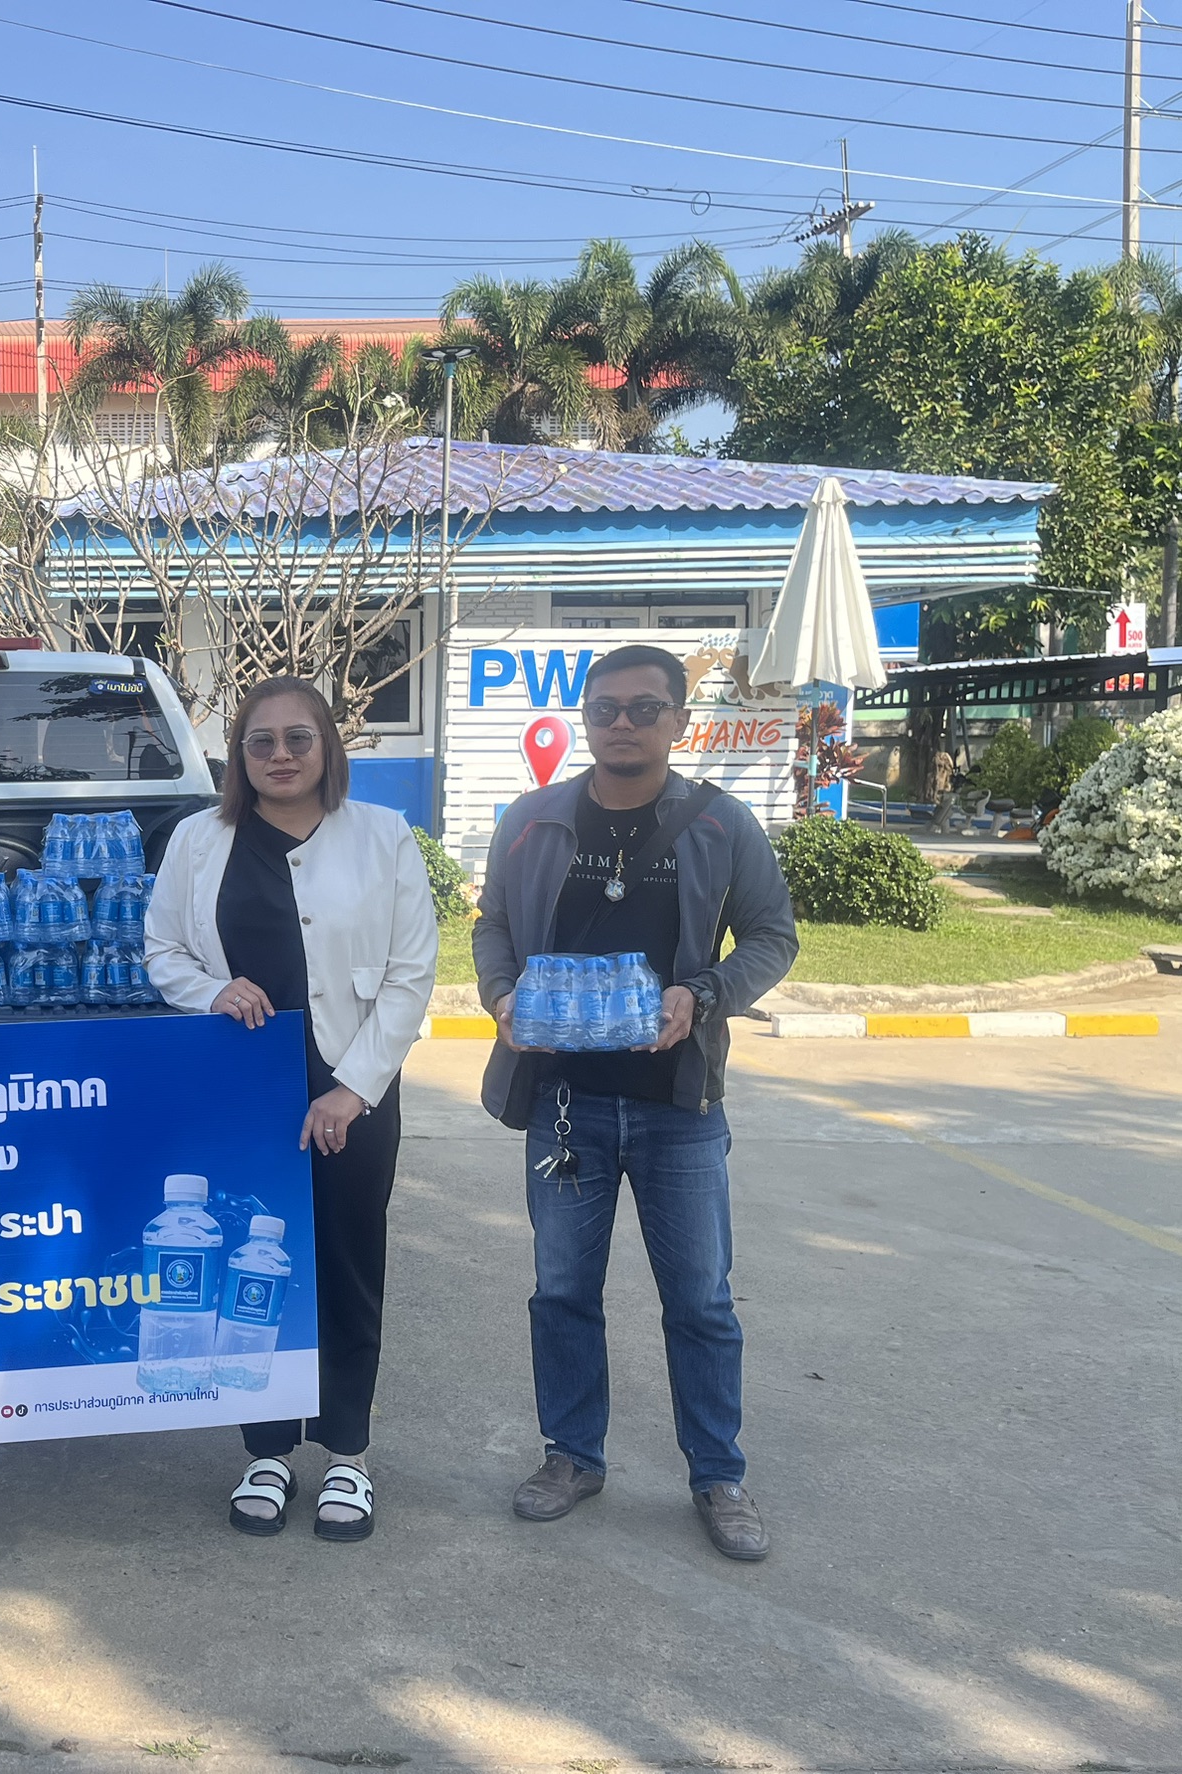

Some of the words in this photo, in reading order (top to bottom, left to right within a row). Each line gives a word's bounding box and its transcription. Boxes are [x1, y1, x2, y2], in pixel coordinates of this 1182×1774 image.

[1128, 630, 1143, 641] 500
[468, 648, 594, 708] PW
[34, 1393, 145, 1414] การประปาส่วนภูมิภาค
[148, 1386, 220, 1404] สำนักงานใหญ่
